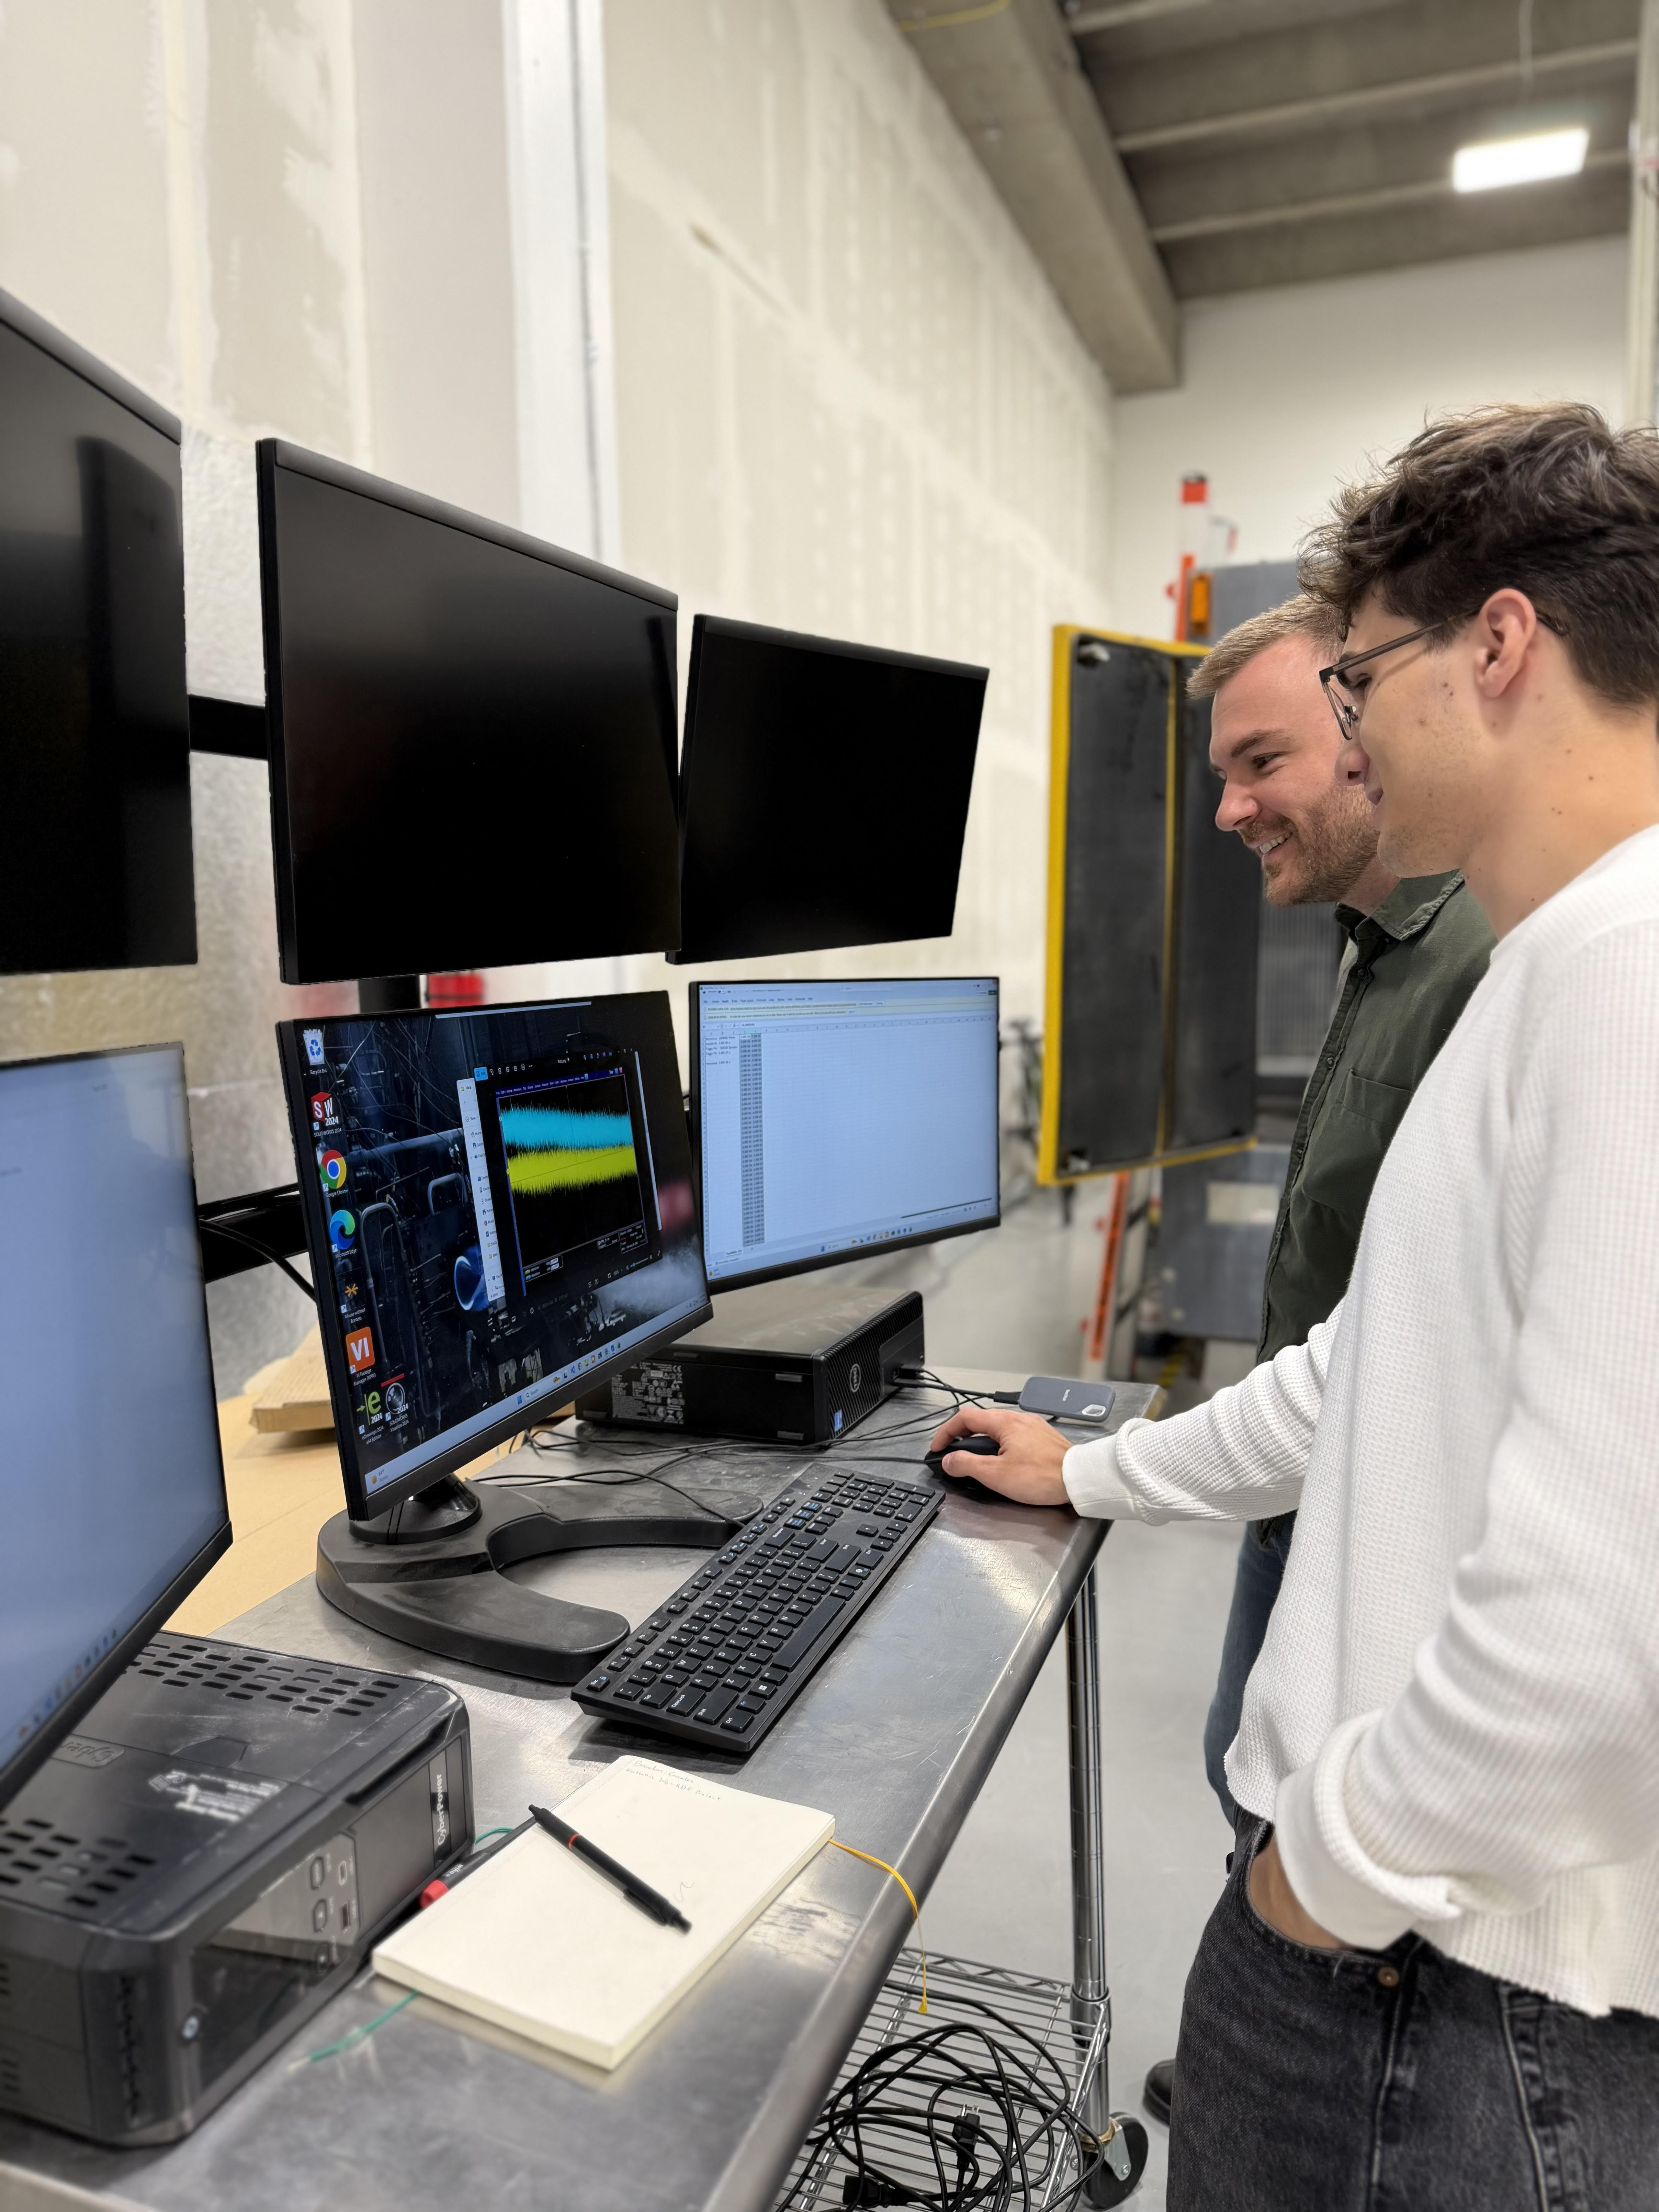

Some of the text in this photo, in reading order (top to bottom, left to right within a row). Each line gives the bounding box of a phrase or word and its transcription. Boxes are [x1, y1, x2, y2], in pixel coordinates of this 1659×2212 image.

[325, 1116, 339, 1126] 2024
[314, 1129, 334, 1137] SOLIDWORKS
[335, 1250, 349, 1259] Microsoft
[350, 1337, 370, 1361] VI
[360, 1368, 372, 1376] Package
[354, 1377, 366, 1386] Manager
[397, 1403, 409, 1414] 2024
[370, 1412, 383, 1424] 2024
[389, 1413, 408, 1426] SOLIDWORKS
[362, 1429, 377, 1440] eDrawings
[371, 1434, 382, 1442] Edition
[671, 1700, 679, 1708] Caps
[633, 1760, 663, 1773] Brendan
[676, 1783, 692, 1791] RDE
[436, 1774, 447, 1846] CyberPower
